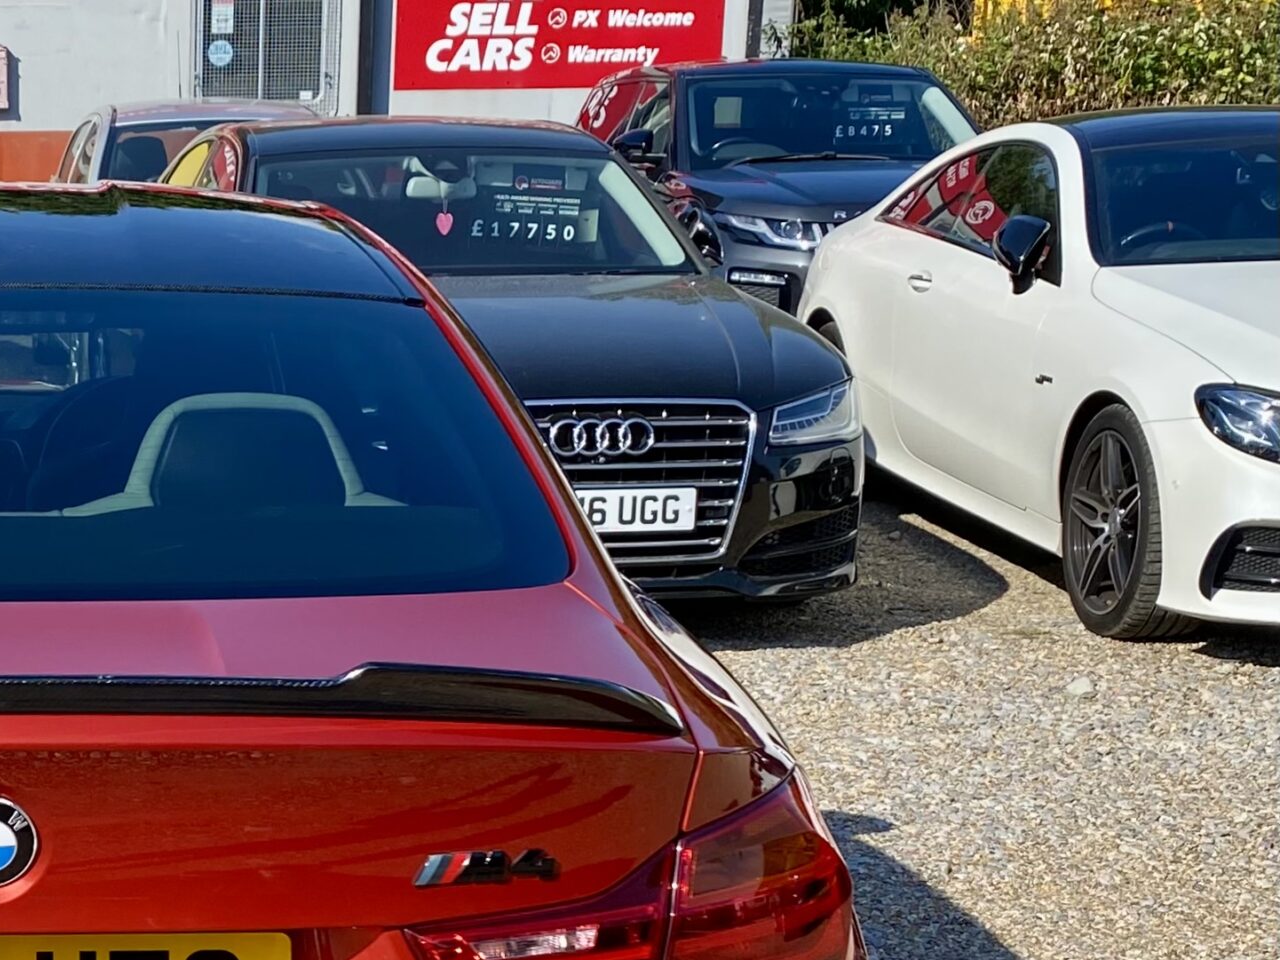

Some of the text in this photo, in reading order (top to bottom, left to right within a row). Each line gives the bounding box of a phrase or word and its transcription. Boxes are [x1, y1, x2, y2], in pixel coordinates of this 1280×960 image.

[445, 2, 539, 37] SELL
[572, 9, 695, 28] PX Welcome
[424, 37, 536, 73] CARS
[567, 45, 660, 67] Warranty
[471, 219, 575, 241] £17750
[618, 494, 681, 525] UGG
